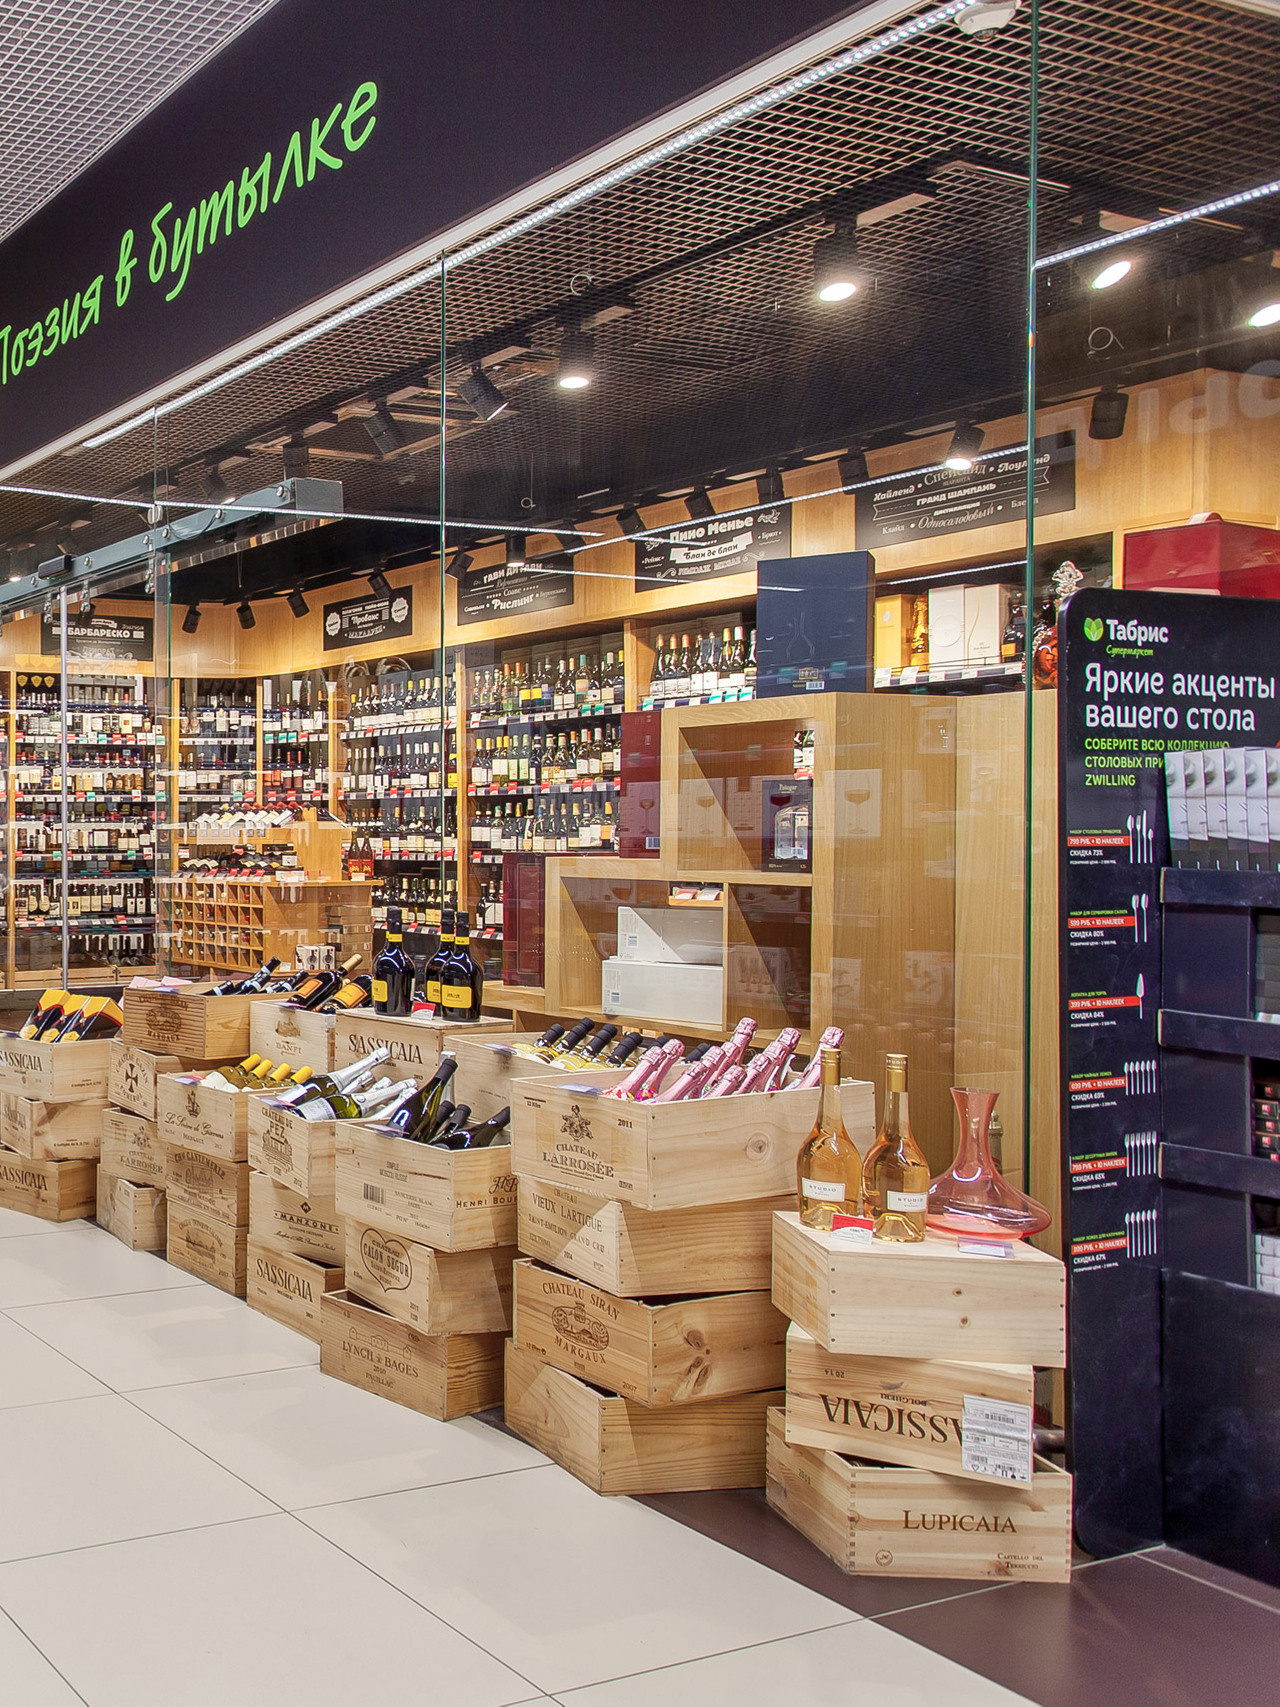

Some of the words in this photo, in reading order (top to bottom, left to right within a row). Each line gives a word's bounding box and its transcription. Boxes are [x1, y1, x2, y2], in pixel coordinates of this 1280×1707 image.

[116, 229, 137, 306] в
[149, 81, 377, 301] бутылке
[873, 485, 915, 501] Хайленд
[997, 454, 1051, 473] Лоулнд
[916, 492, 946, 506] ГРАНД
[947, 483, 996, 499] ШАМПАНЬ
[1011, 497, 1039, 508] Блед
[669, 527, 705, 543] Пино
[707, 516, 753, 536] Менье
[683, 551, 706, 560] Блан
[707, 548, 716, 556] де
[717, 543, 738, 554] блан
[483, 569, 505, 584] ГАВИ
[506, 566, 519, 577] ДИ
[503, 588, 522, 596] Соаве
[492, 593, 534, 610] Рислинг
[351, 613, 379, 625] Прованс
[67, 627, 130, 638] БАРБАРЕСКО
[1106, 619, 1169, 646] Табрис
[1106, 645, 1154, 659] Супермаркет
[1085, 662, 1164, 701] Яркие
[1172, 673, 1275, 702] акценты
[1085, 704, 1179, 729] вашего
[1186, 707, 1255, 731] стола
[1085, 738, 1138, 750] СОБЕРИТЕ
[1141, 739, 1164, 751] ВСЮ
[1085, 756, 1142, 768] СТОЛОВЫХ
[1145, 757, 1164, 768] ПРИ
[1085, 774, 1136, 786] ZWILLING
[1070, 1012, 1093, 1020] СКИДКА
[275, 1041, 302, 1055] BANFI
[348, 1033, 423, 1065] SASSICAIA
[1071, 1093, 1093, 1101] СКИДКА
[261, 1106, 283, 1127] CHATEAU
[284, 1116, 294, 1129] DE
[617, 1118, 633, 1129] 2011
[269, 1120, 285, 1139] PEZ
[555, 1143, 599, 1159] CHATEAU
[542, 1151, 615, 1179] L'ARROSÉE
[1072, 1174, 1094, 1183] СКИДКА
[553, 1187, 578, 1204] CHATEAU
[809, 1184, 837, 1193] STUDIO
[456, 1199, 487, 1209] HENRI
[493, 1195, 517, 1205] BOU
[532, 1192, 557, 1214] VIEUX
[560, 1204, 603, 1233] LARTIGUE
[280, 1212, 334, 1233] MANZONE
[528, 1213, 568, 1239] SAINT-EMILION
[570, 1231, 590, 1248] GRAND
[592, 1240, 605, 1254] CRU
[371, 1239, 401, 1259] CHATEAU
[363, 1243, 383, 1266] CALON
[387, 1255, 409, 1278] SEGUR
[1073, 1255, 1095, 1264] СКИДКА
[256, 1258, 313, 1303] SASSICAIA
[542, 1282, 585, 1299] CHATEAU
[590, 1293, 620, 1321] SIRAN
[553, 1335, 607, 1364] MARGAUX
[342, 1341, 374, 1362] LYNCH
[384, 1358, 419, 1378] BAGES
[365, 1373, 394, 1389] PAUILLAC
[824, 1368, 845, 1379] 2014
[621, 1381, 637, 1393] 2007
[880, 1392, 927, 1407] BOLGHERI
[818, 1393, 963, 1446] ASSICAIA
[902, 1509, 1017, 1533] LUPICAIA
